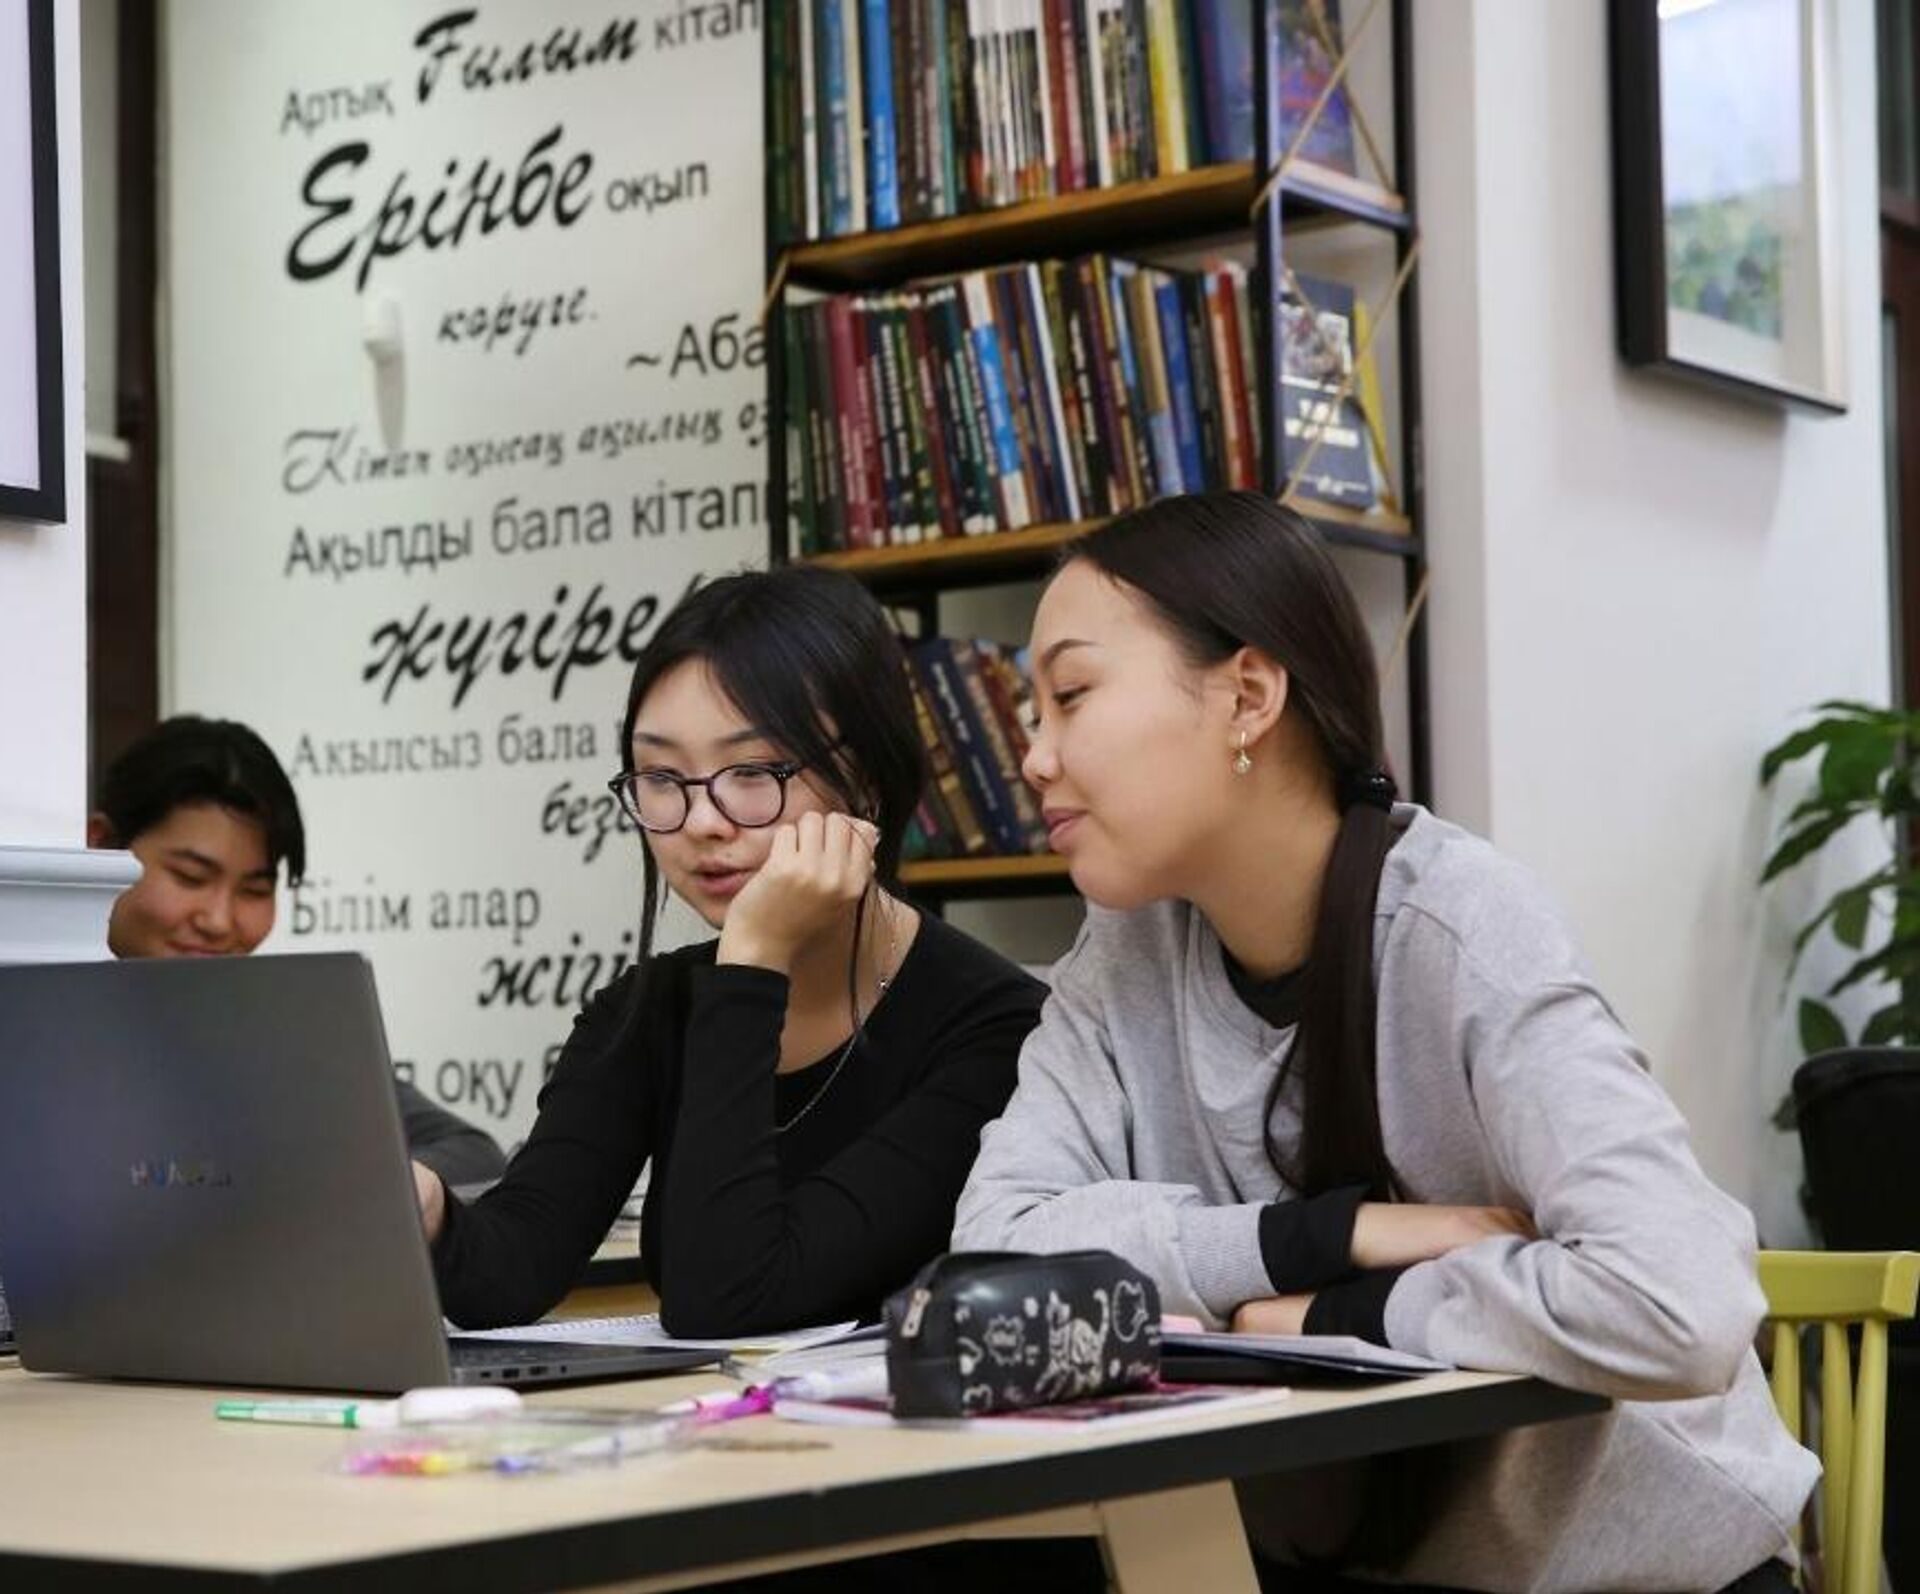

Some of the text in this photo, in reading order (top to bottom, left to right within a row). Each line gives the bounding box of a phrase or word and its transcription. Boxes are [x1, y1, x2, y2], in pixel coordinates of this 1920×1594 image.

[413, 8, 641, 104] Ғылым
[284, 123, 709, 294] Ерінбе оқып
[284, 478, 768, 580] Ақылды бала кітап
[361, 573, 704, 710] жүгіре
[497, 713, 597, 765] бала
[428, 886, 541, 947] алар
[435, 1058, 523, 1122] оқу
